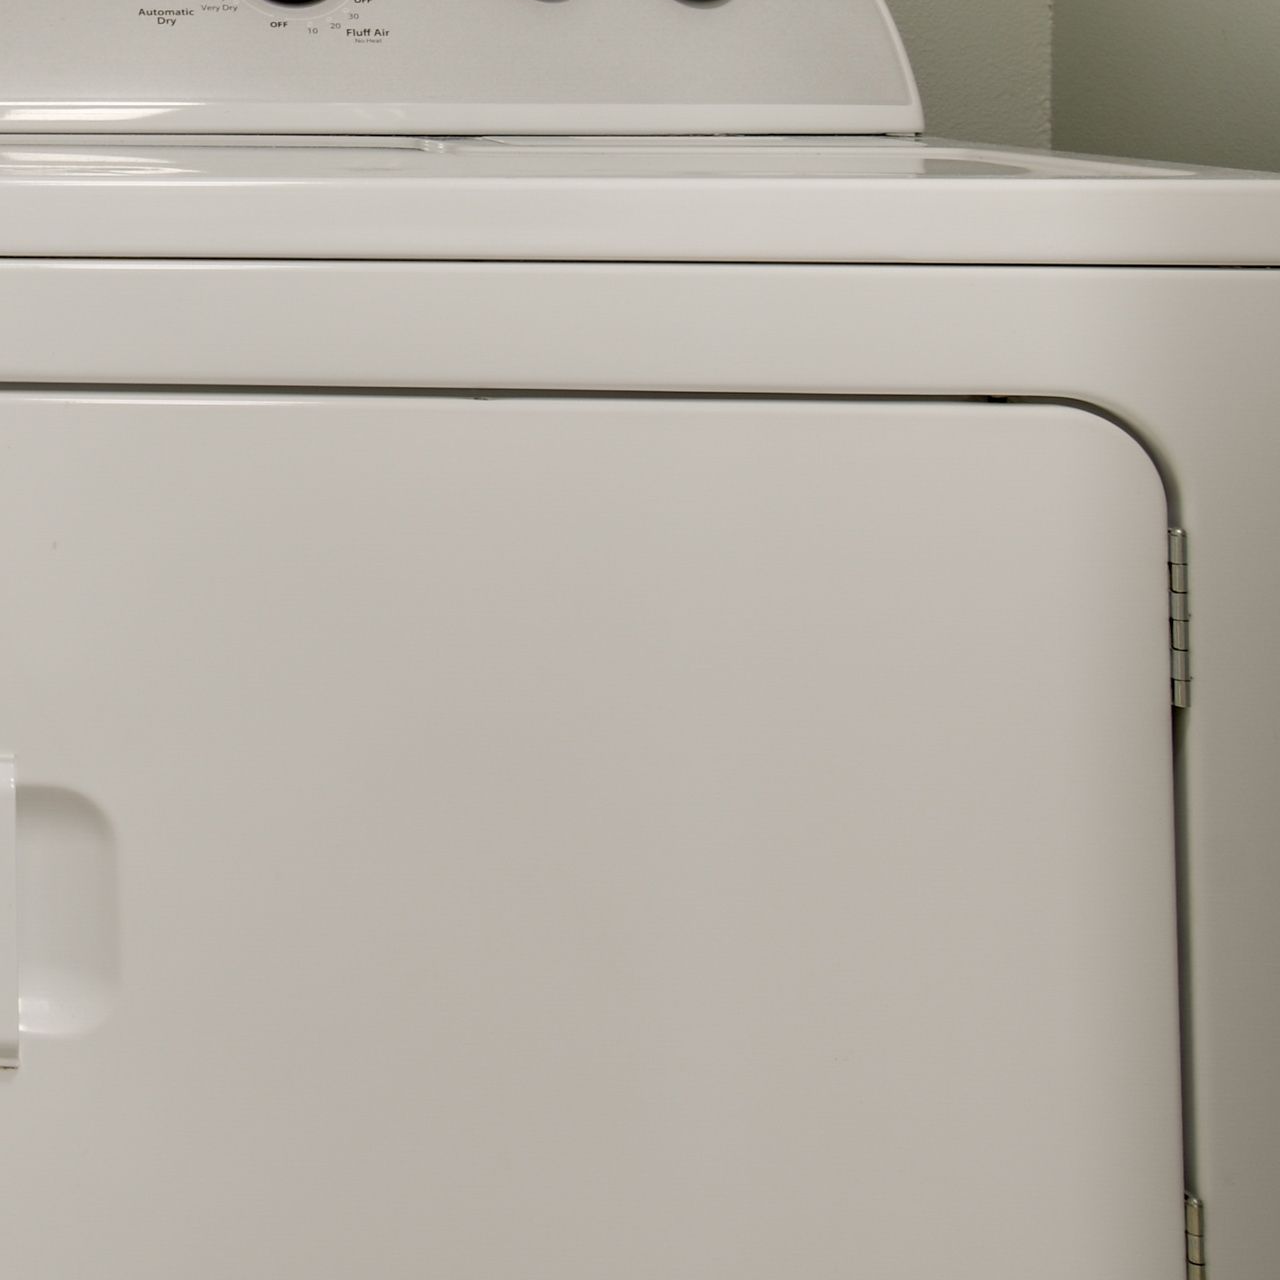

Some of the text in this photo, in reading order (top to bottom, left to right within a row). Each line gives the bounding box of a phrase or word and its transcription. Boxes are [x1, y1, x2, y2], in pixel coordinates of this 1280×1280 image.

[138, 8, 195, 16] Automatic
[201, 4, 239, 13] Very Dry
[157, 16, 177, 26] Dry
[346, 28, 390, 37] Fluff Air
